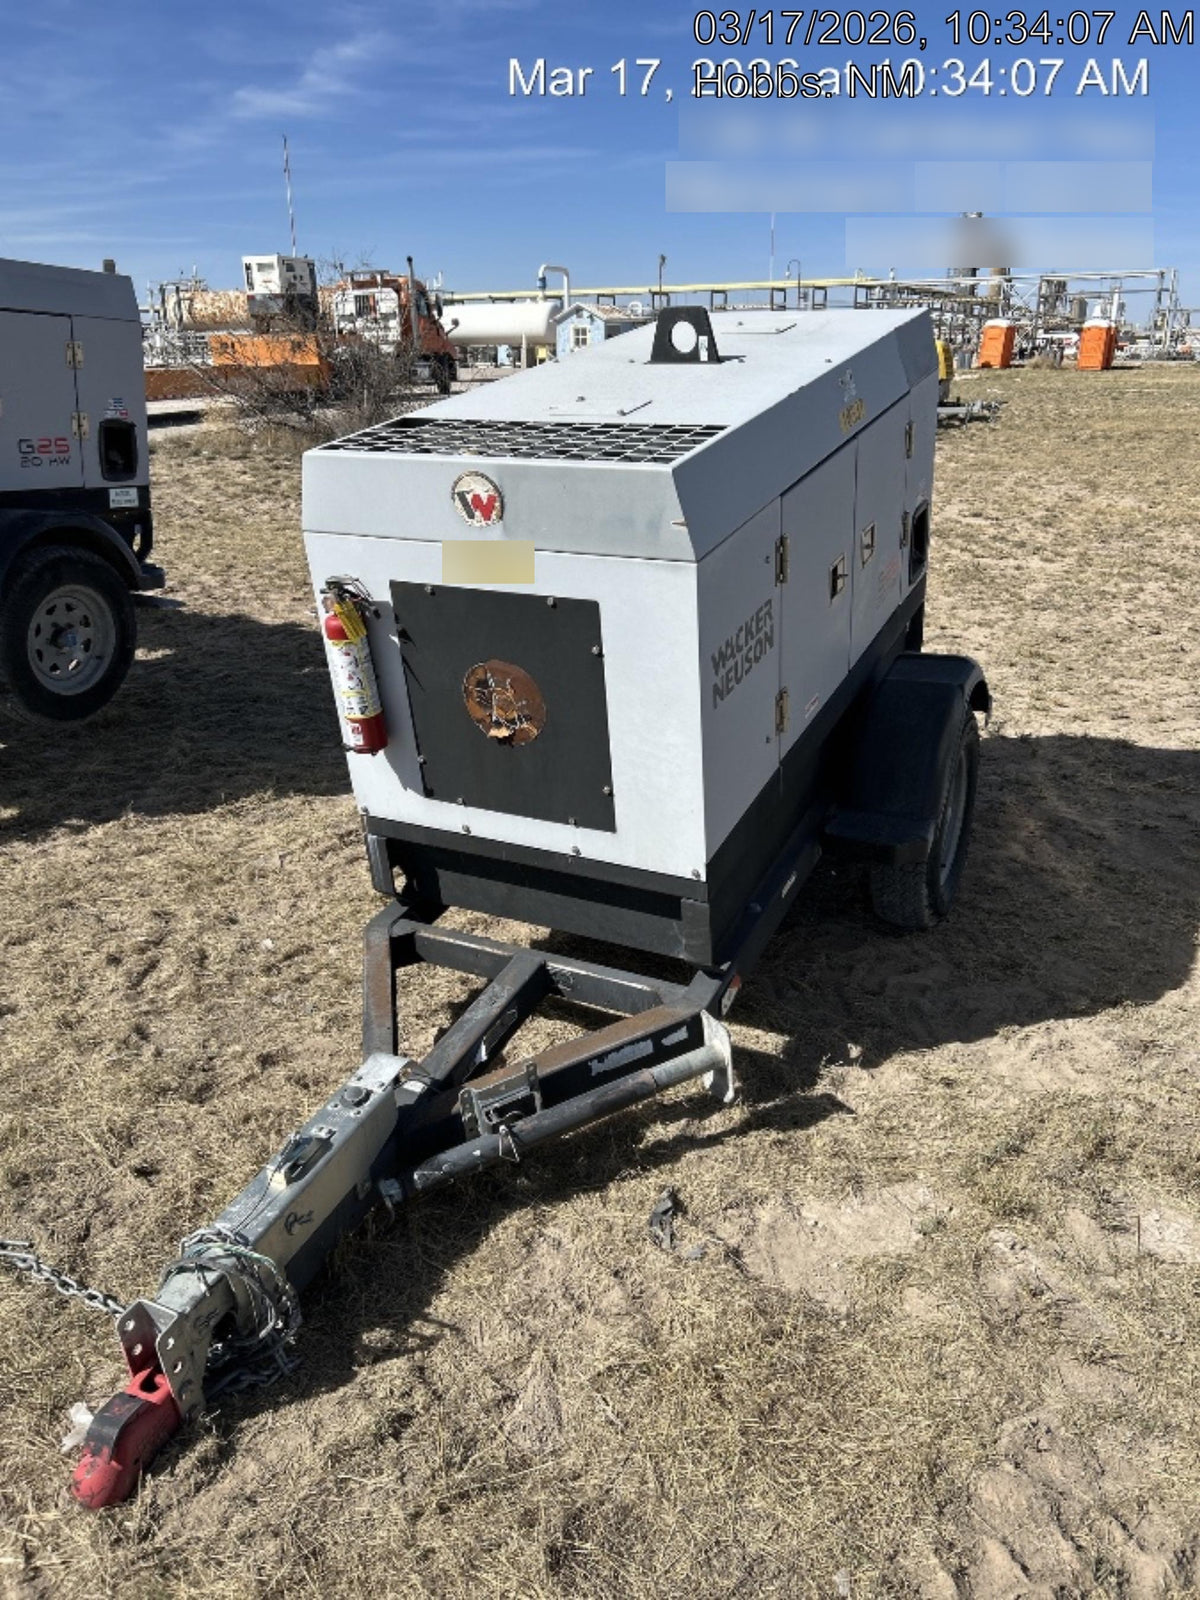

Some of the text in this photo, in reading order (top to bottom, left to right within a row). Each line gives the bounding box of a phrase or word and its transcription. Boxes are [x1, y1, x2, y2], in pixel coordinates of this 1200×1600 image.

[18, 437, 70, 455] G25
[711, 598, 773, 677] WACKER
[712, 623, 774, 710] NEUSON
